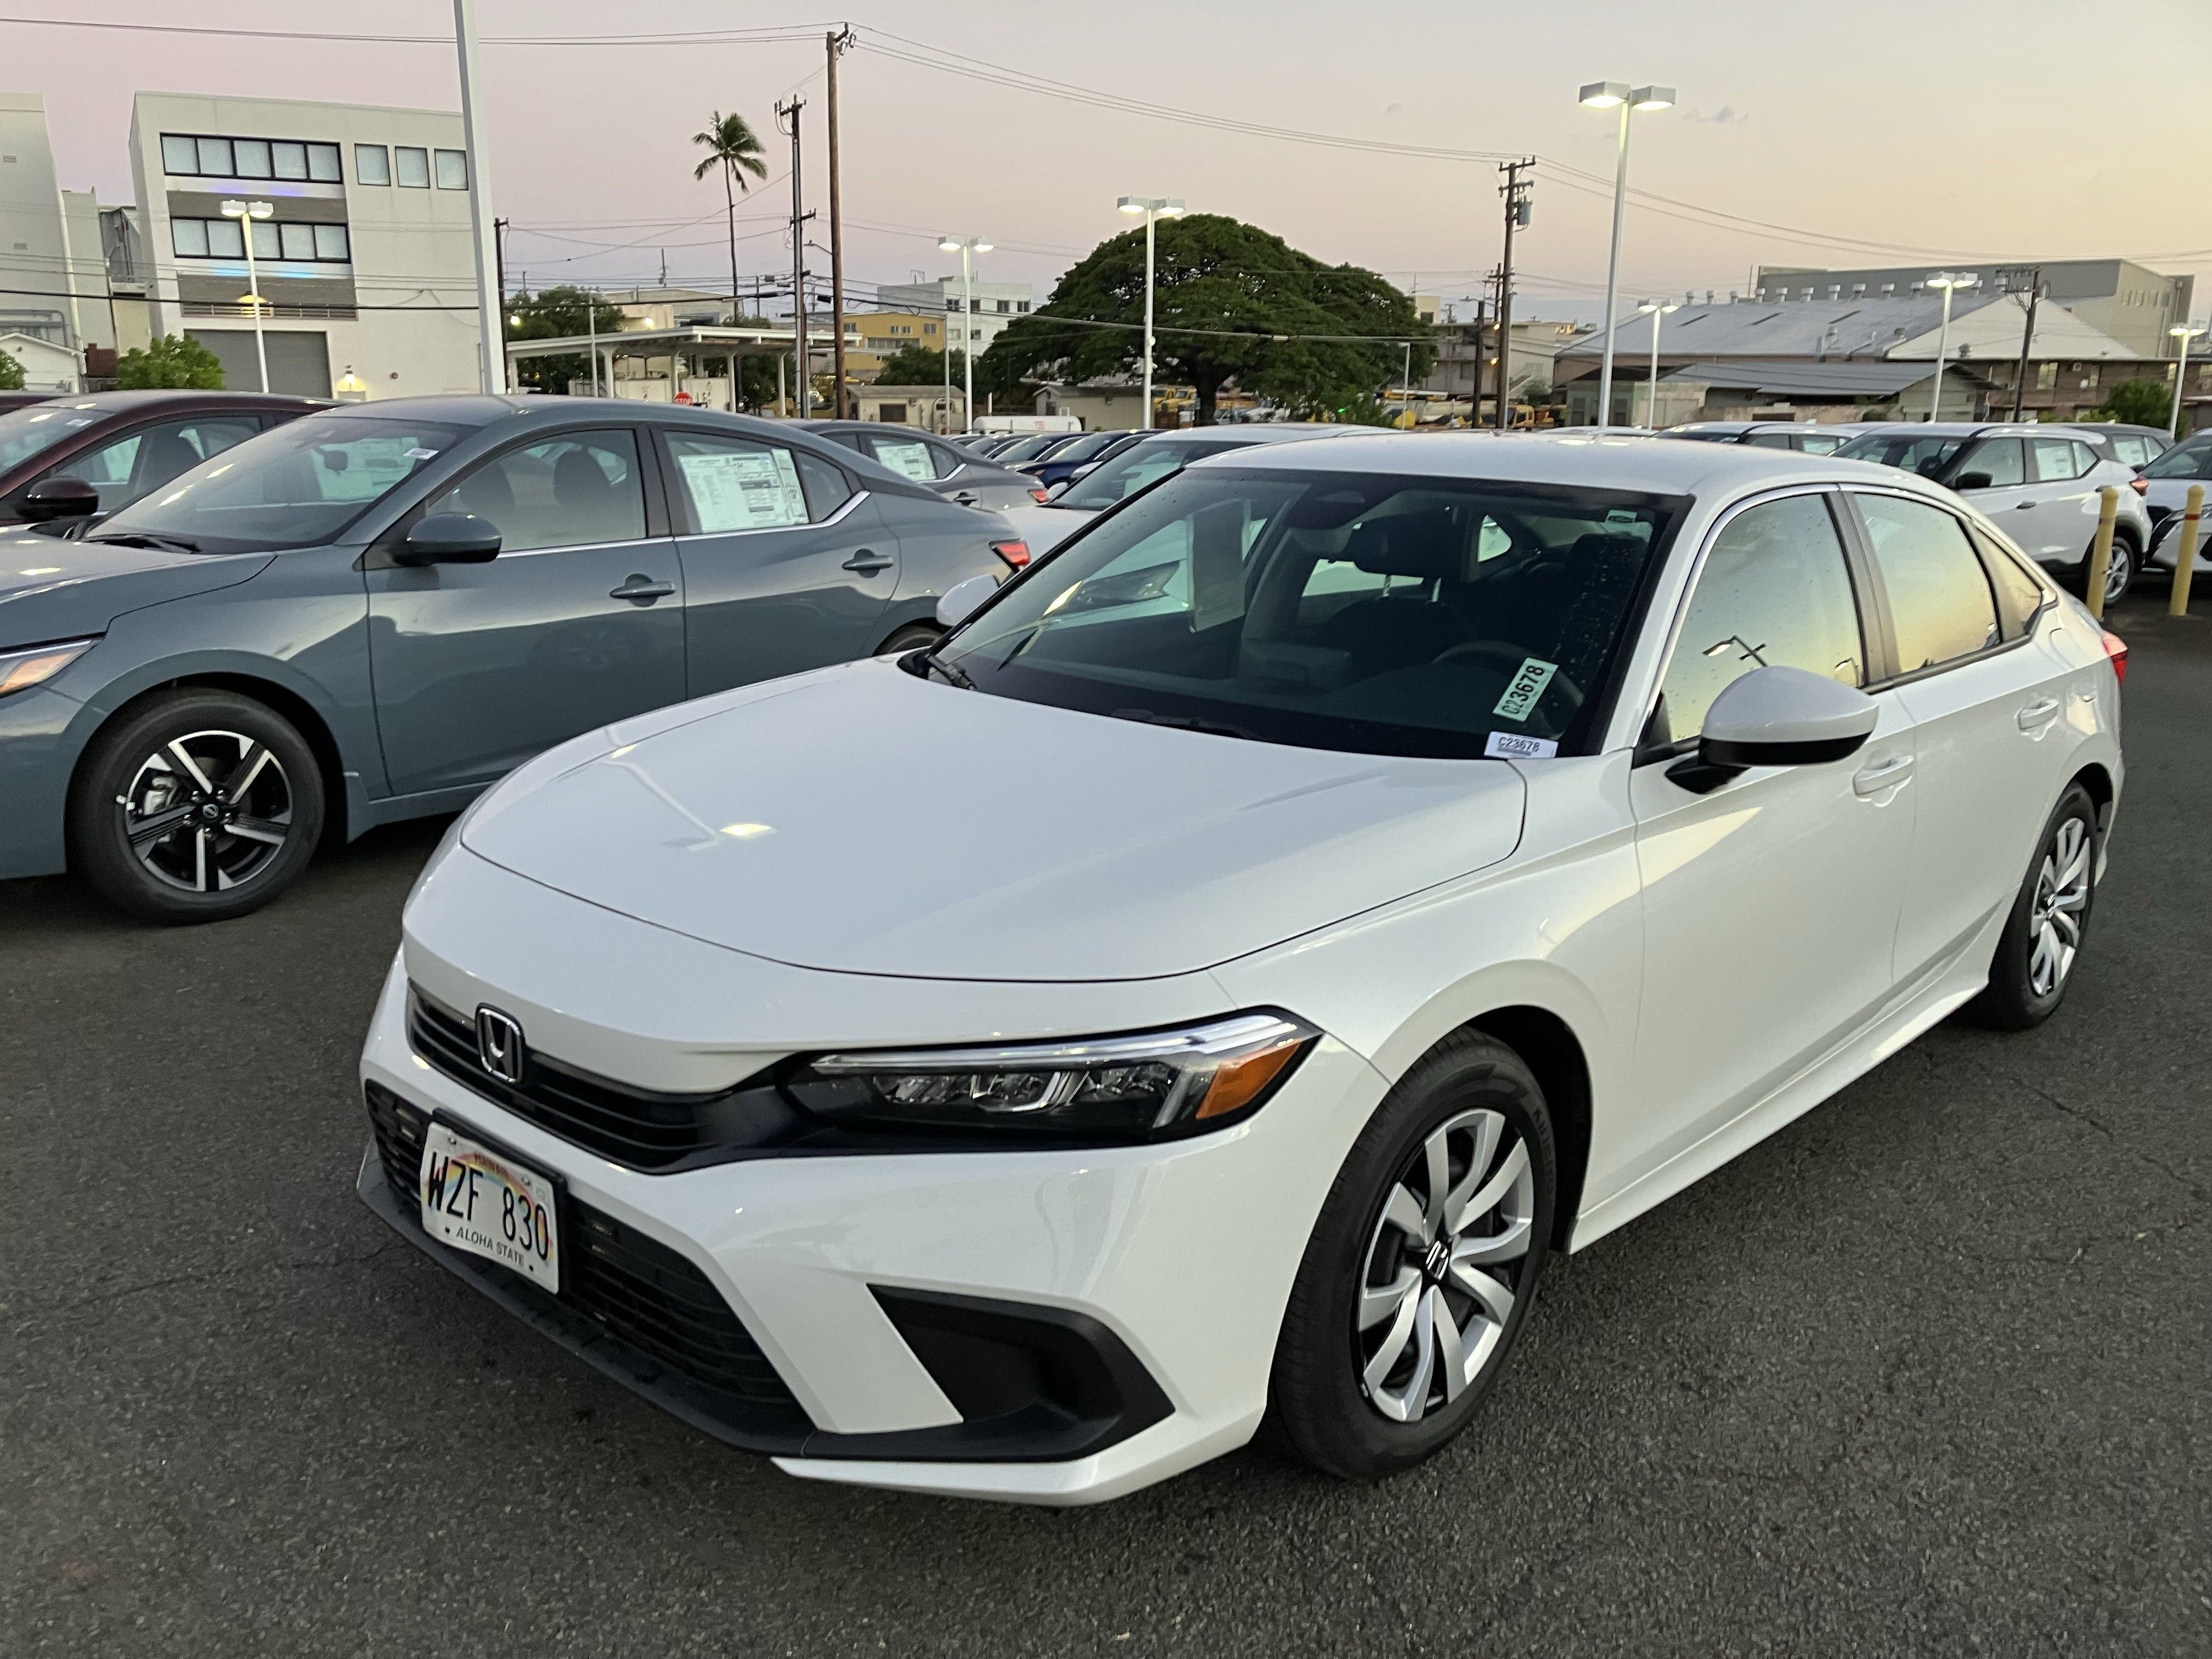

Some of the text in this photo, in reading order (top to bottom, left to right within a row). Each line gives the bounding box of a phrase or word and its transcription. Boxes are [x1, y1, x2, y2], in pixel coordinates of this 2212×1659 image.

[1502, 665, 1544, 714] C23678
[1498, 737, 1541, 752] C23678
[428, 1152, 549, 1261] WZF 830
[456, 1227, 524, 1267] ALOHA STATE
